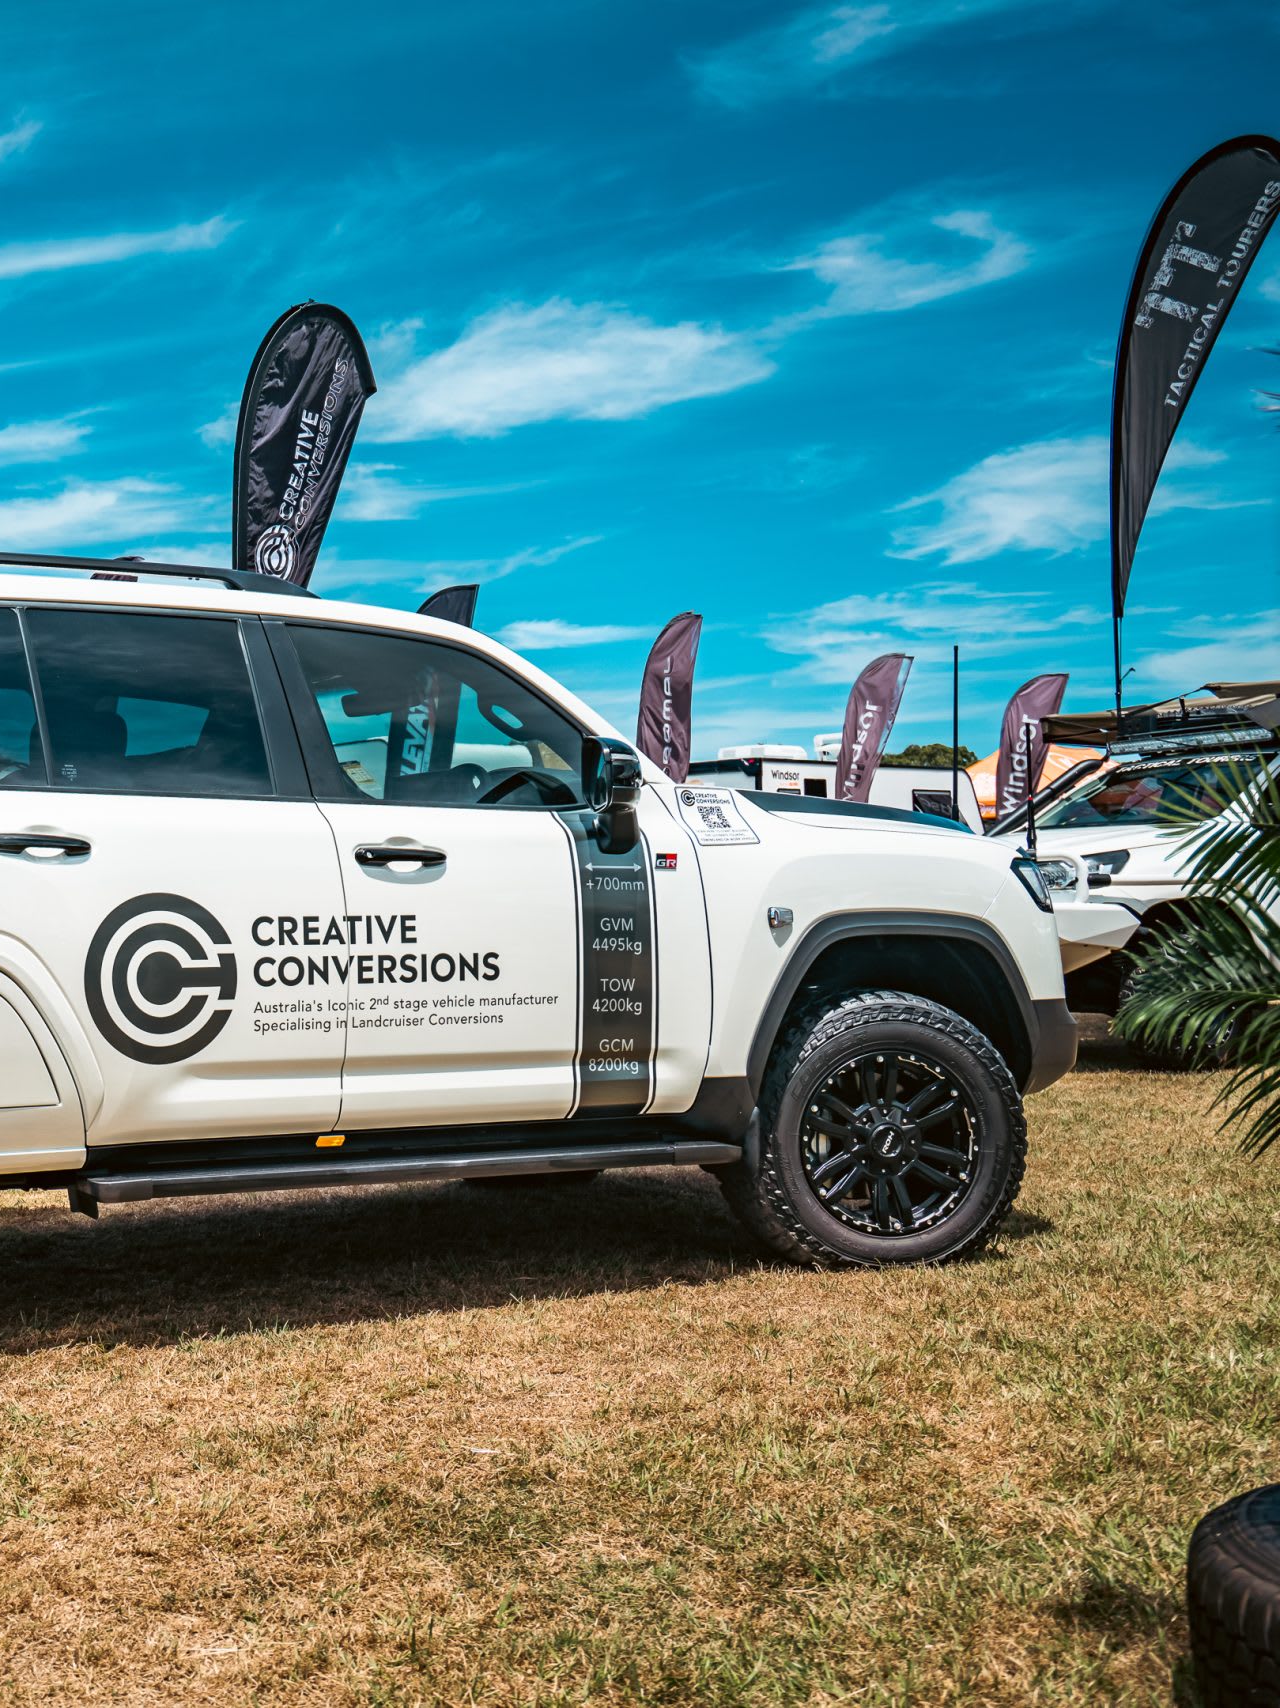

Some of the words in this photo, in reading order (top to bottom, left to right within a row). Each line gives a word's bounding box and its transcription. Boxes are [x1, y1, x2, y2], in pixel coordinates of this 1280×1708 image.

[1164, 298, 1224, 408] TACTICAL
[1217, 180, 1280, 288] TOURERS
[295, 357, 349, 530] CONVERSIONS
[279, 409, 319, 520] CREATIVE
[771, 769, 800, 780] Windsor
[656, 858, 677, 868] GR
[586, 877, 645, 891] +700mm
[251, 915, 417, 946] CREATIVE
[600, 918, 634, 932] GVM
[592, 938, 642, 955] 4495kg
[253, 952, 500, 987] CONVERSIONS
[600, 978, 635, 992] TOW
[253, 998, 323, 1014] Australia's
[327, 998, 365, 1012] Iconic
[393, 998, 428, 1013] stage
[432, 995, 475, 1008] vehicle
[479, 993, 559, 1007] manufacturer
[592, 998, 642, 1015] 4200kg
[253, 1018, 331, 1035] Specialising
[336, 1018, 348, 1029] in
[351, 1015, 424, 1029] Landcruiser
[428, 1012, 504, 1026] Conversions
[599, 1039, 634, 1052] GCM
[588, 1058, 639, 1074] 8200kg
